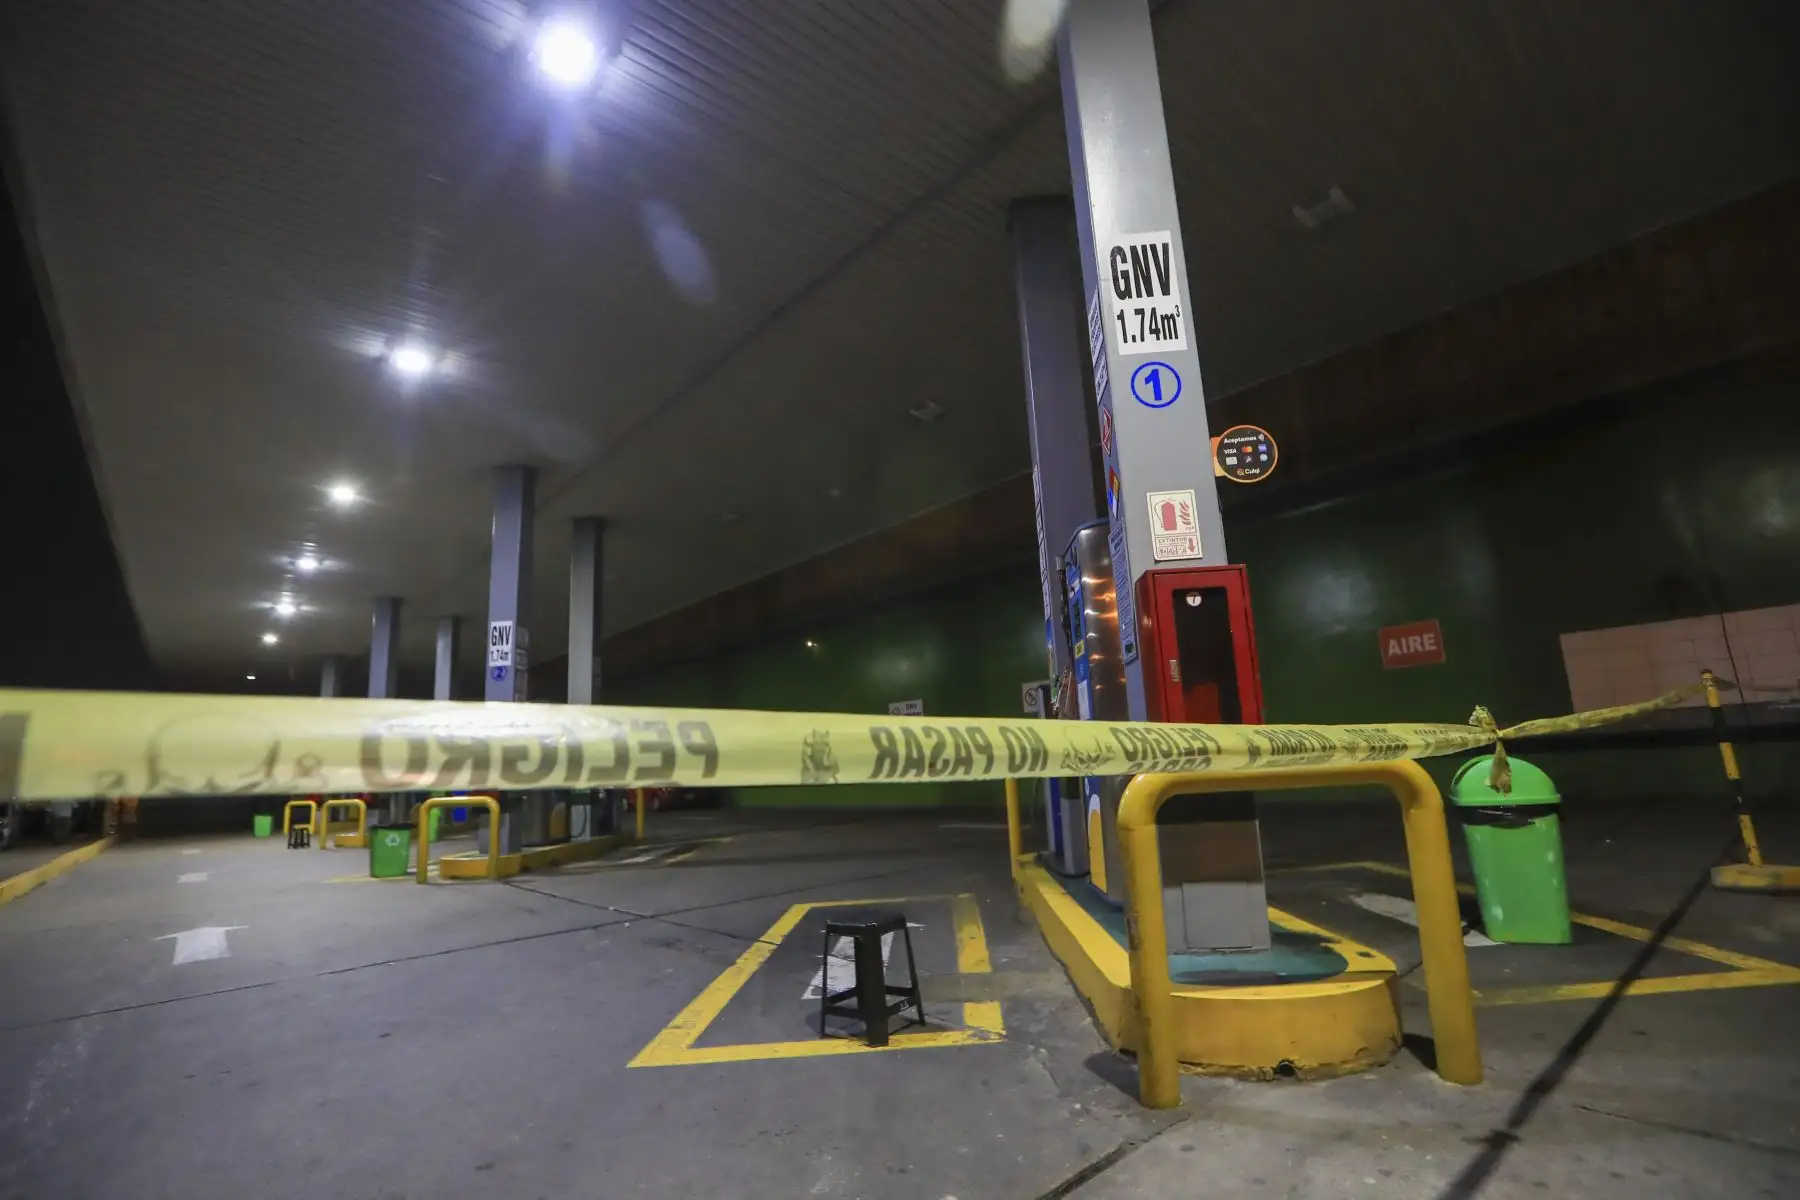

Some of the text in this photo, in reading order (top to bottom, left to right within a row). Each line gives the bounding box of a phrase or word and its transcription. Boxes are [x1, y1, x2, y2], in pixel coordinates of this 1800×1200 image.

[1110, 242, 1171, 301] GNV
[1144, 368, 1163, 401] 1
[1223, 435, 1257, 444] Aceptamos
[491, 625, 512, 647] GNV
[1388, 632, 1438, 658] AIRE
